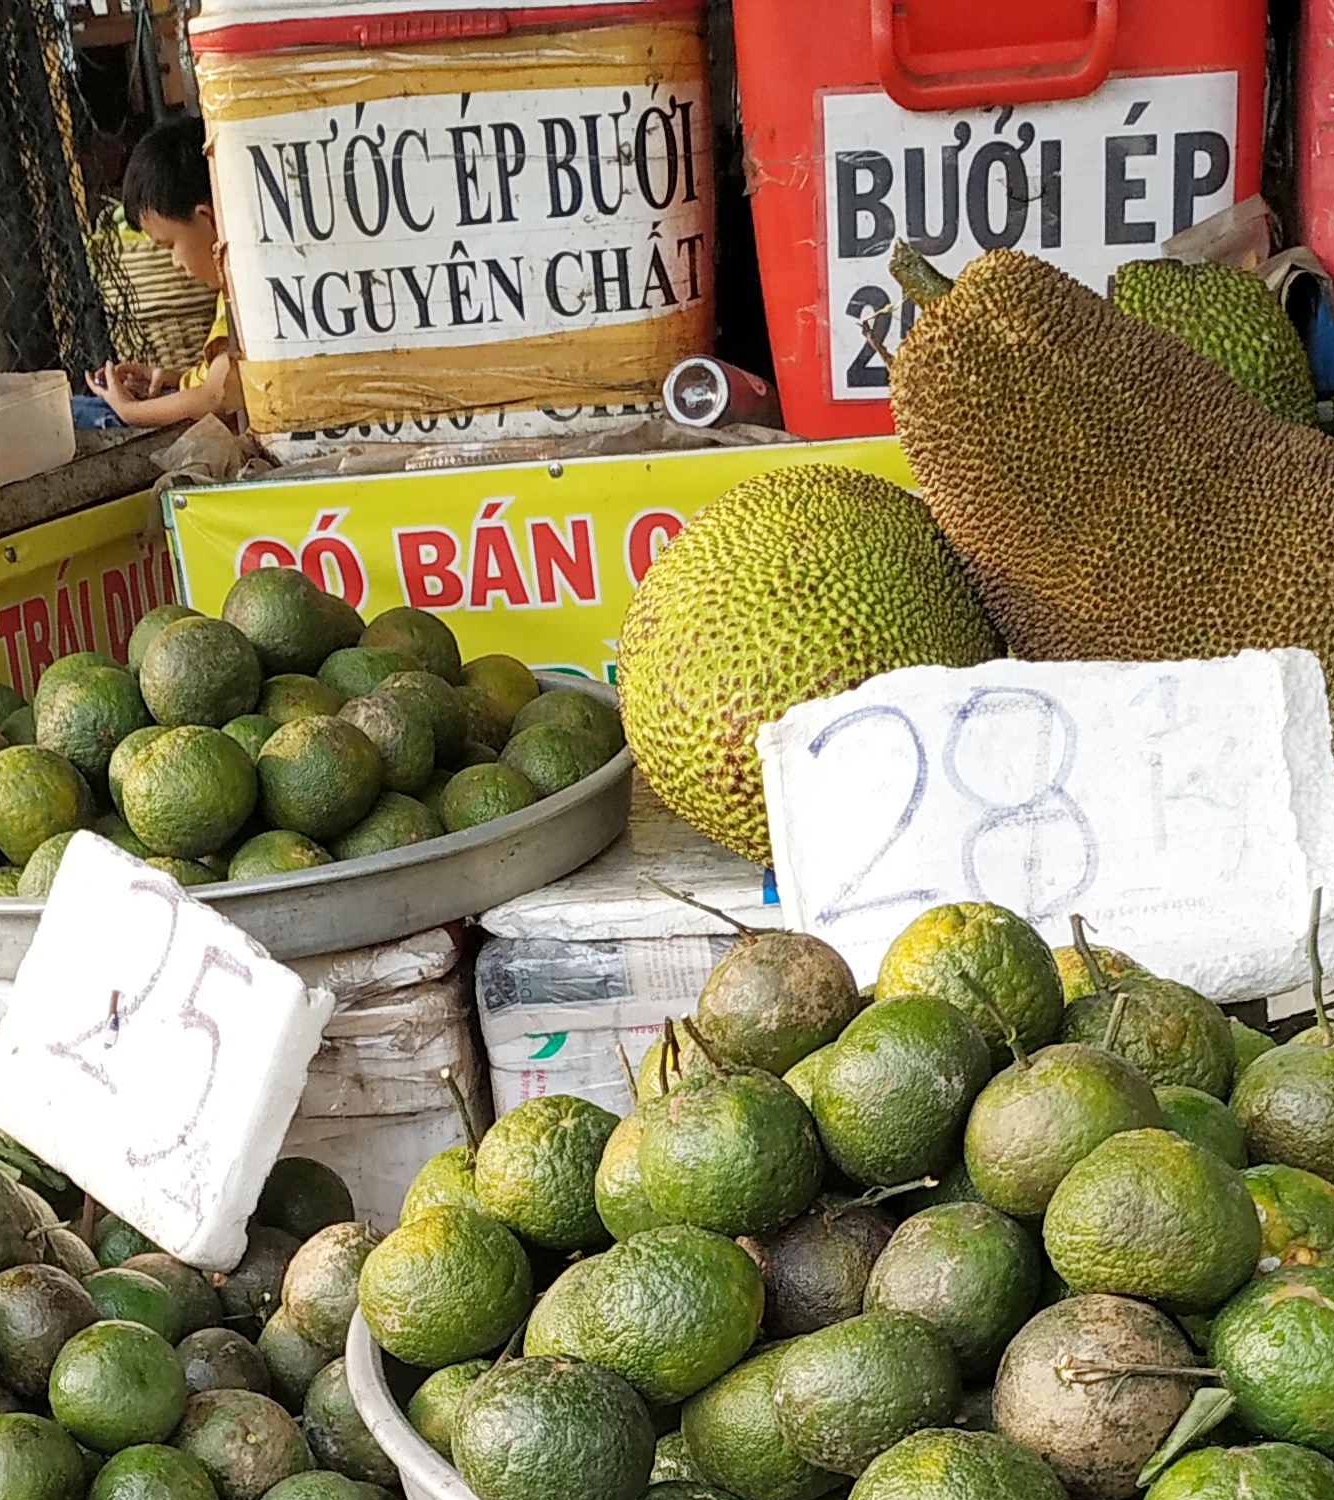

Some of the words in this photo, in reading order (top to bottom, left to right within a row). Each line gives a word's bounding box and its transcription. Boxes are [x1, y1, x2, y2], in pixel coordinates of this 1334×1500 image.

[246, 102, 436, 245] NƯỚC
[450, 91, 527, 228] ÉP
[834, 105, 1063, 260] BƯỞI
[1104, 101, 1230, 246] ÉP
[266, 240, 528, 342] NGUYÊN
[544, 221, 705, 318] CHẤT
[396, 501, 597, 609] BÁN
[808, 684, 1100, 927] 28
